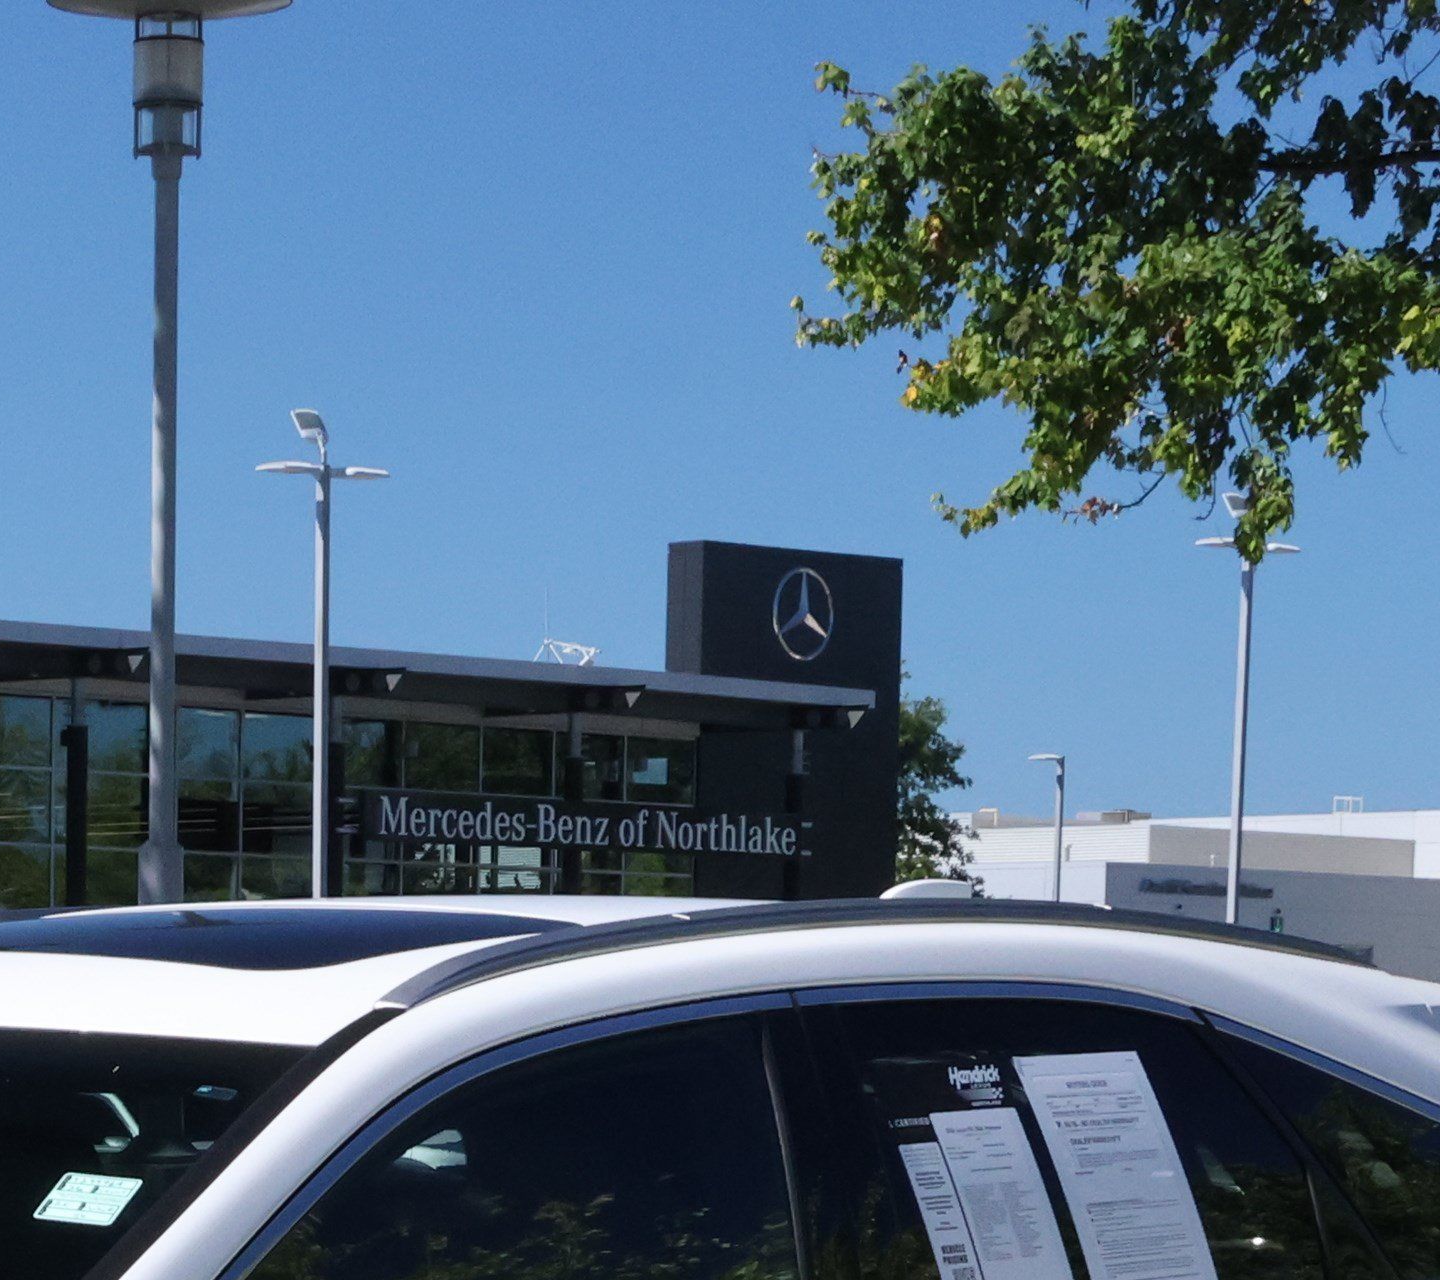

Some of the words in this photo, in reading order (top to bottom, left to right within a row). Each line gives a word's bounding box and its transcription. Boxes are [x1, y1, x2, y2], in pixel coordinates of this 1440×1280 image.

[378, 795, 610, 846] Mercedes-Benz
[619, 809, 650, 848] of
[654, 811, 797, 856] Northlake
